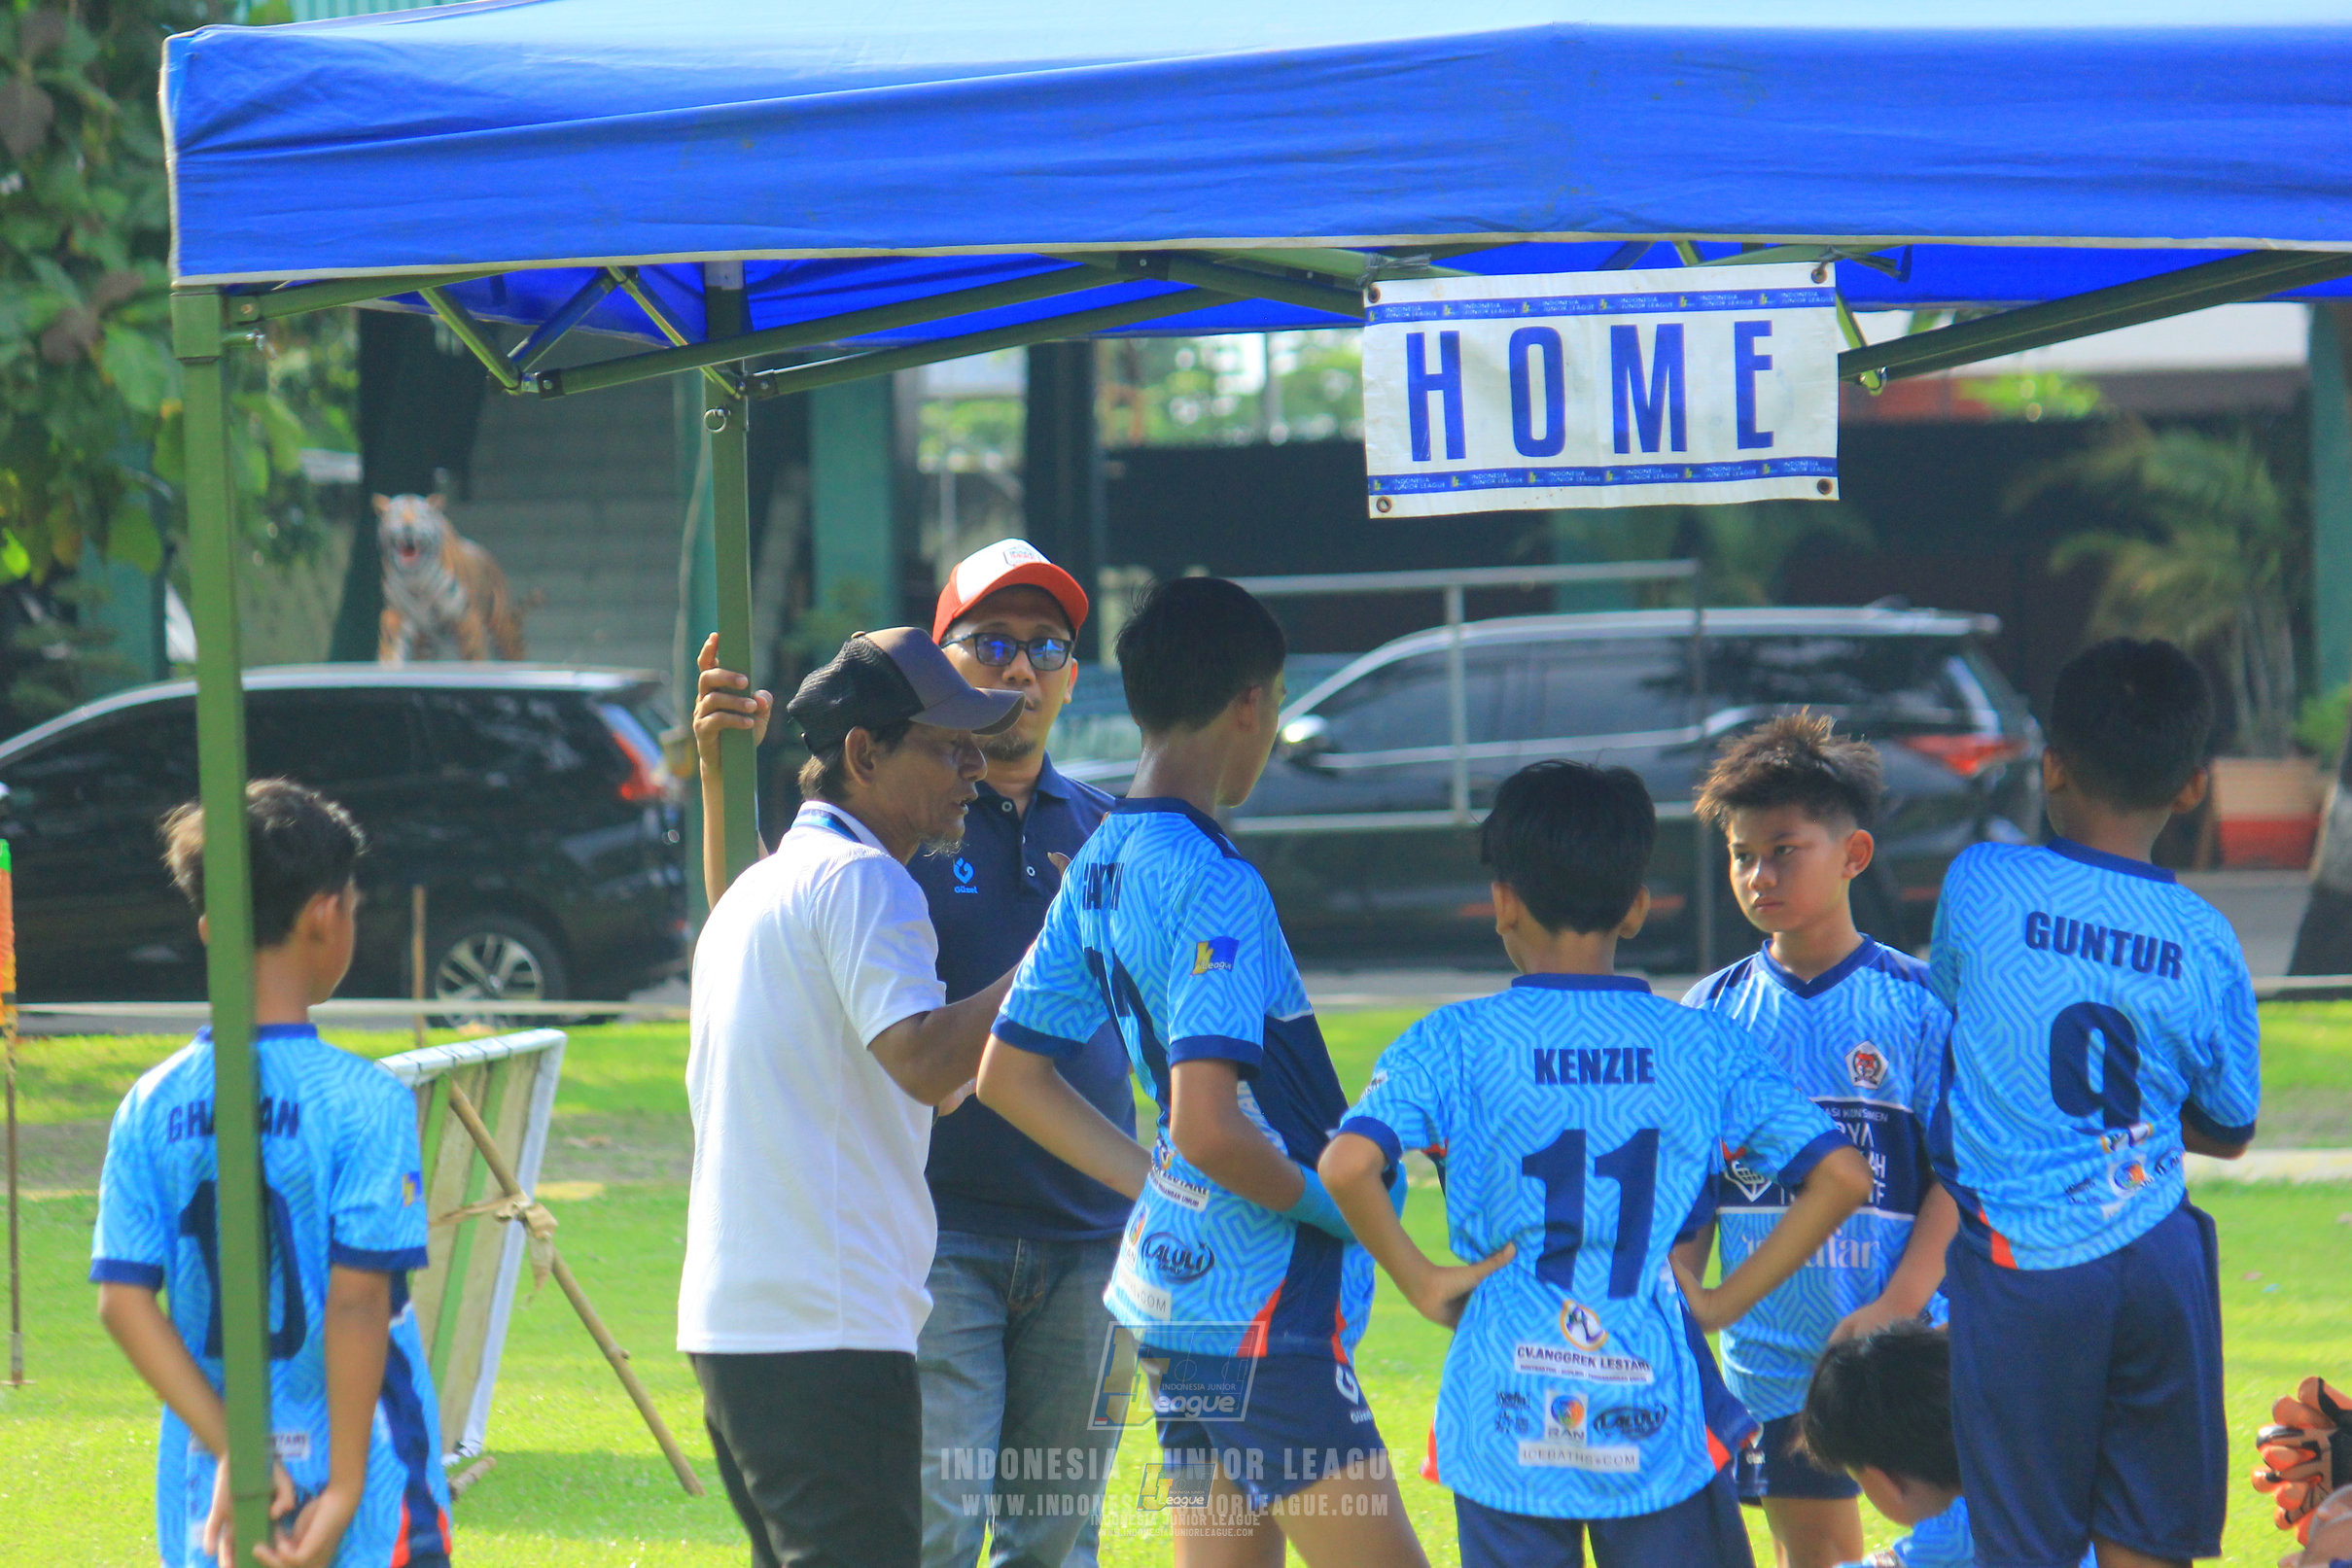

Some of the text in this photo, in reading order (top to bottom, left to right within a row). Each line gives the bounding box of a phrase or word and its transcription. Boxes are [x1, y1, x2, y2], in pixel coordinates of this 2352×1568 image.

[1406, 320, 1773, 462] HOME
[2025, 911, 2183, 980] GUNTUR
[1533, 1048, 1655, 1085] KENZIE
[1522, 1128, 1660, 1300] 11
